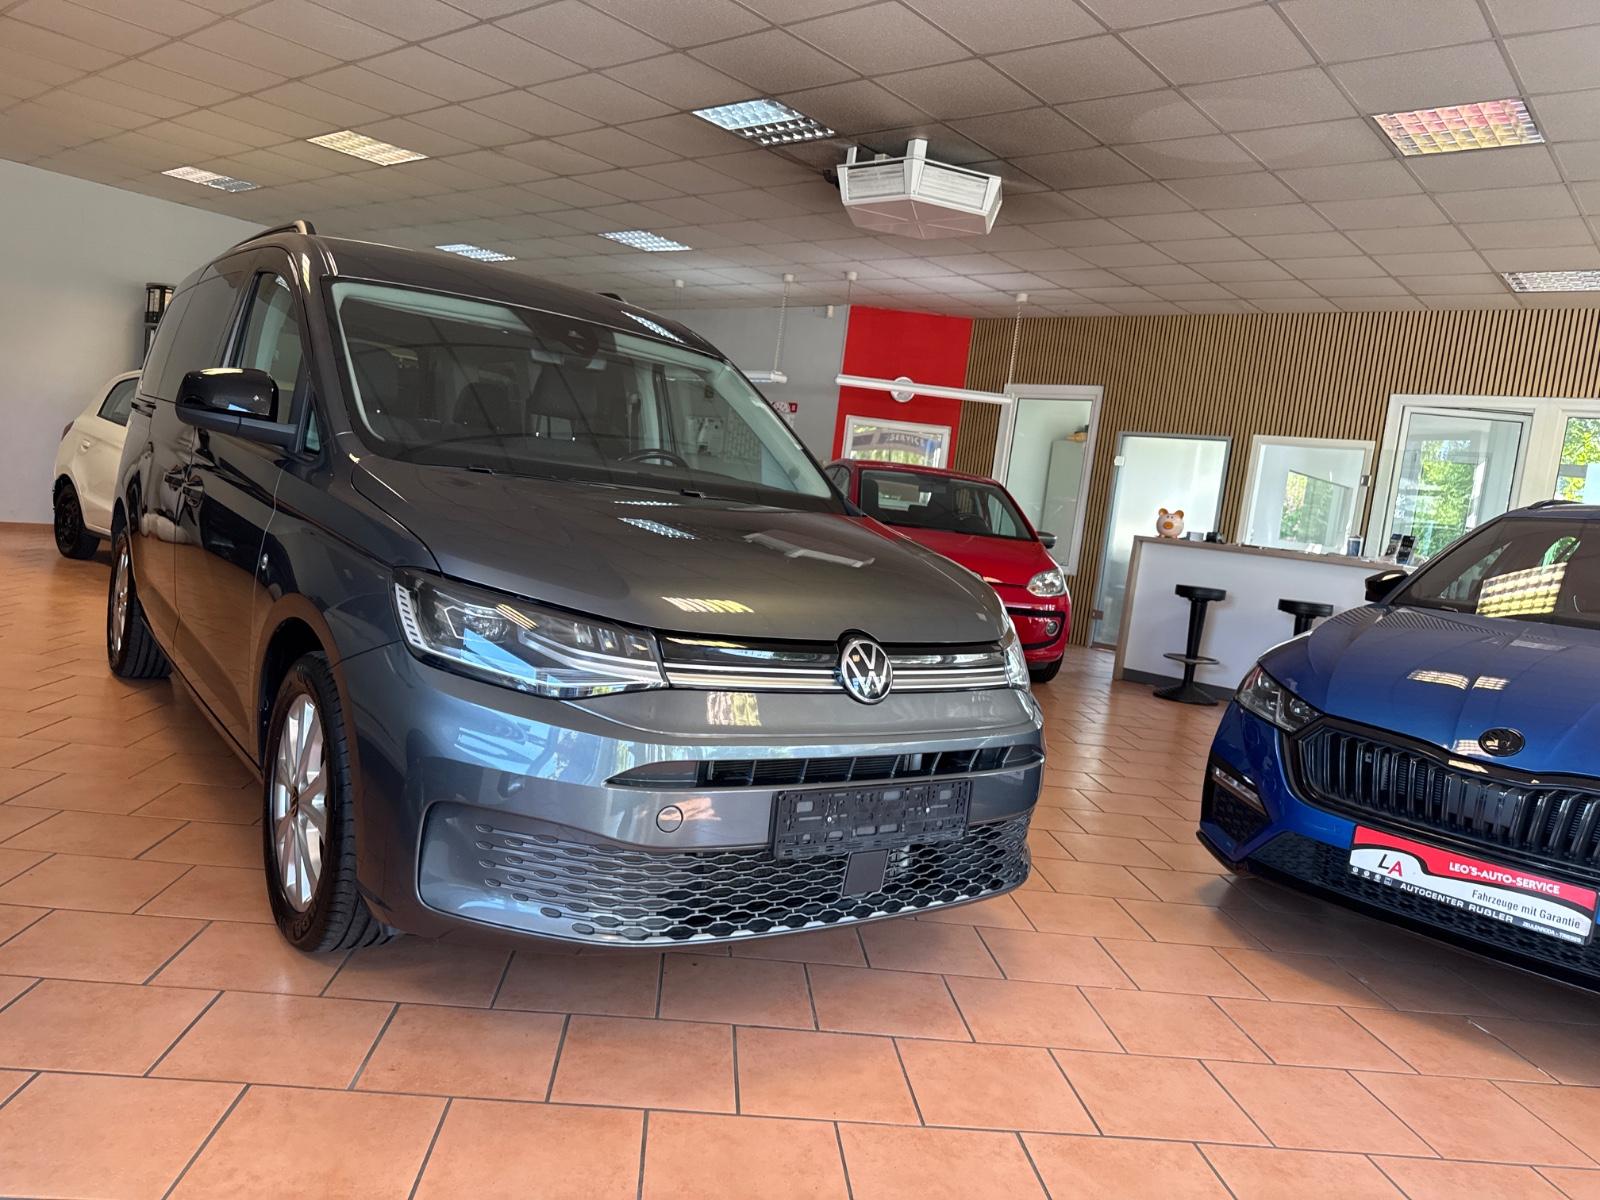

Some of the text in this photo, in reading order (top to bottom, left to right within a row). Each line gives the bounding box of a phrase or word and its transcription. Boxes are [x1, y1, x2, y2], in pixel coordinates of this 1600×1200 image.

[1377, 853, 1403, 877] LA
[1400, 882, 1464, 908] AUTOCENTER
[1471, 889, 1581, 929] Fahrzeuge mit Garantie
